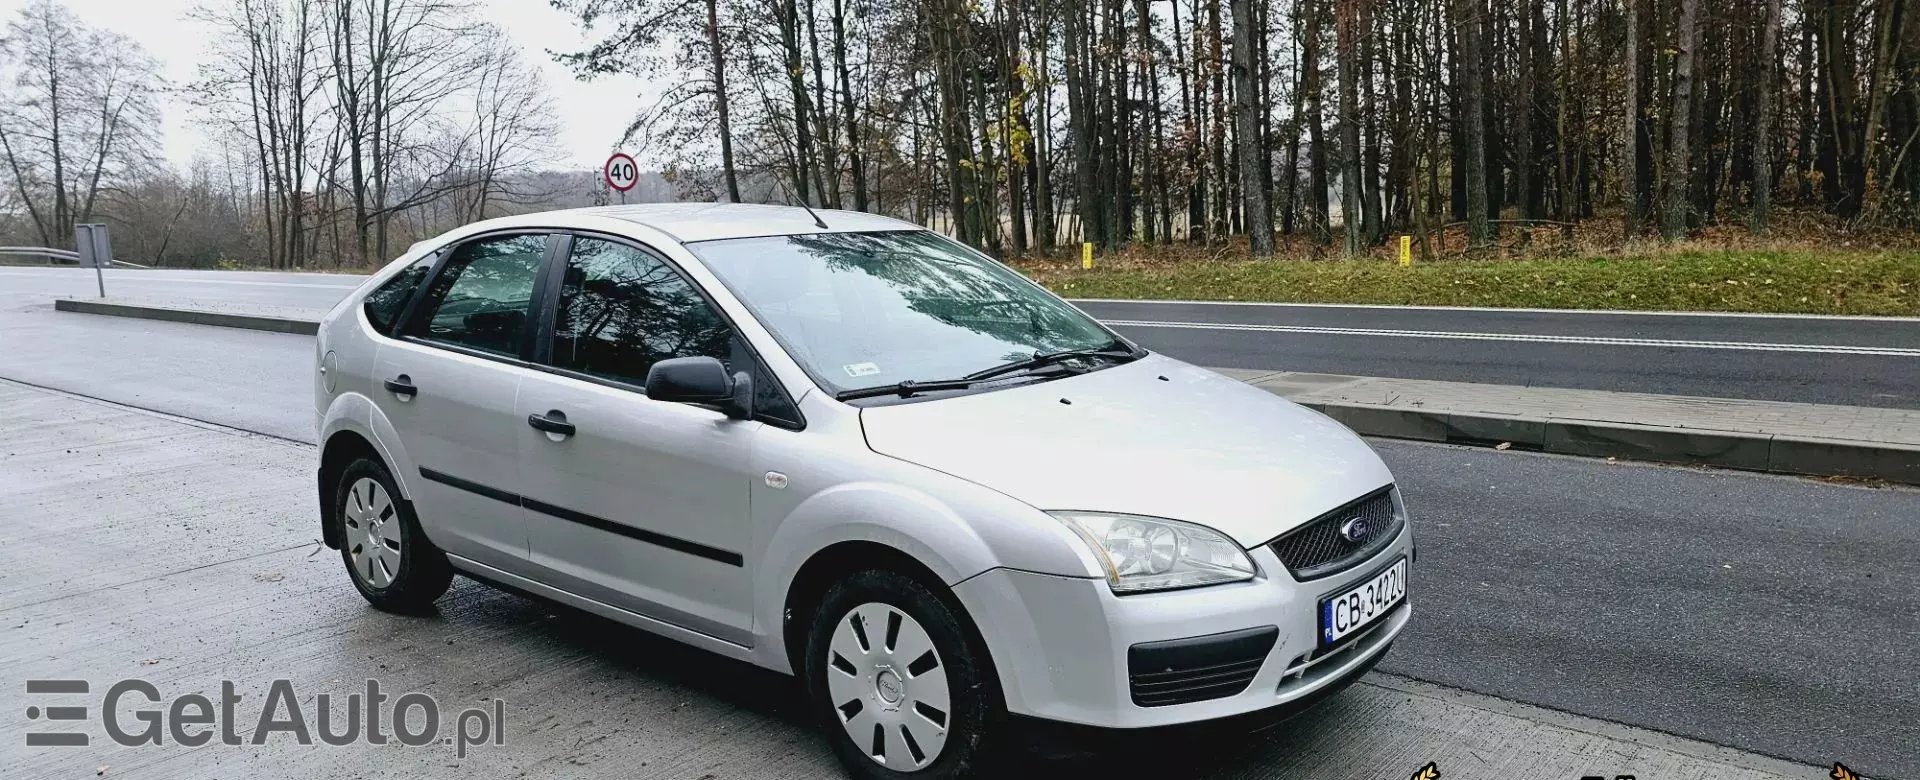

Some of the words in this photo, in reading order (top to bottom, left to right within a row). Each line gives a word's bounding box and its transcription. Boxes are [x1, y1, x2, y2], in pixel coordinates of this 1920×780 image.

[611, 163, 634, 181] 40
[1336, 593, 1361, 633] CB
[1366, 562, 1405, 617] 3422U
